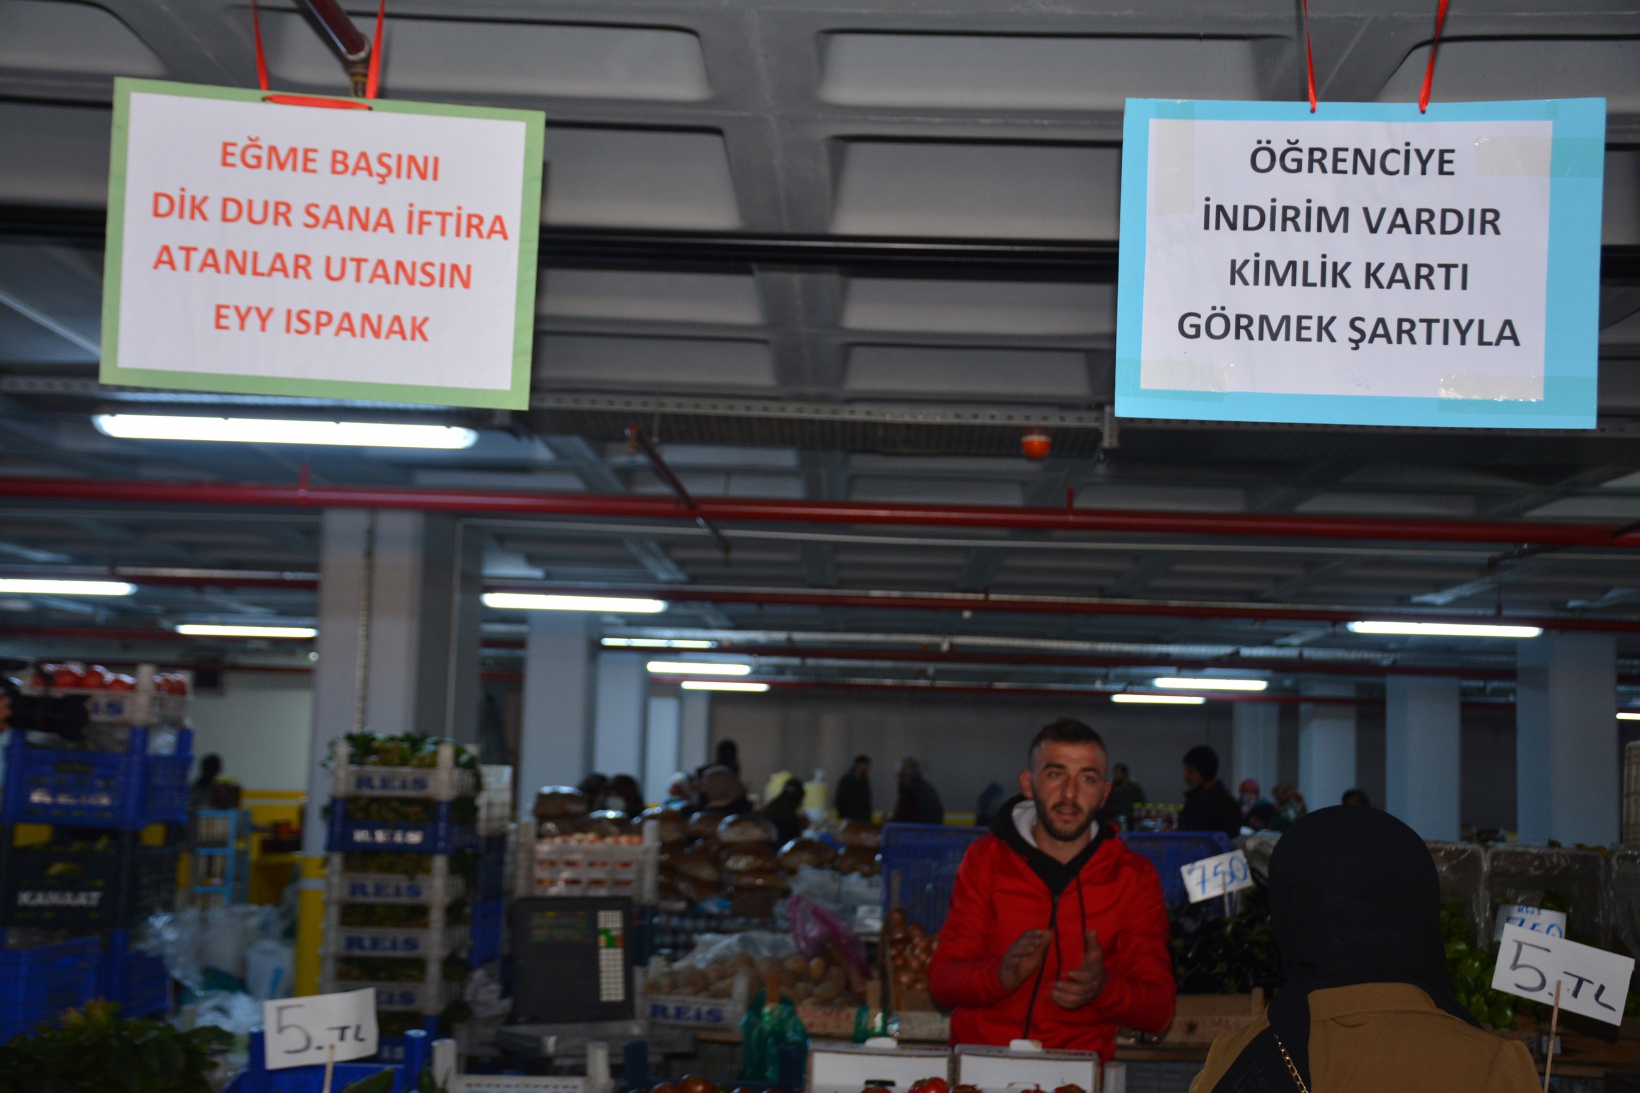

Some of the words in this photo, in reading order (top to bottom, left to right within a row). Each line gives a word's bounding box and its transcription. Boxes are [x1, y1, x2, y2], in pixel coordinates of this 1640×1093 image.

[220, 136, 319, 174] EĞME
[330, 149, 440, 186] BAŞINI
[1250, 138, 1456, 177] ÖĞRENCİYE
[152, 186, 209, 222] DİK
[220, 196, 293, 228] DUR
[303, 202, 396, 234] SANA
[406, 202, 509, 241] İFTİRA
[1203, 196, 1350, 234] İNDİRİM
[1362, 206, 1501, 236] VARDIR
[152, 244, 313, 281] ATANLAR
[324, 255, 473, 290] UTANSIN
[1229, 252, 1352, 289] KİMLİK
[1364, 261, 1468, 291] KARTI
[214, 303, 275, 333] EYY
[284, 308, 430, 343] ISPANAK
[1177, 305, 1337, 343] GÖRMEK
[1348, 316, 1521, 351] ŞARTIYLA
